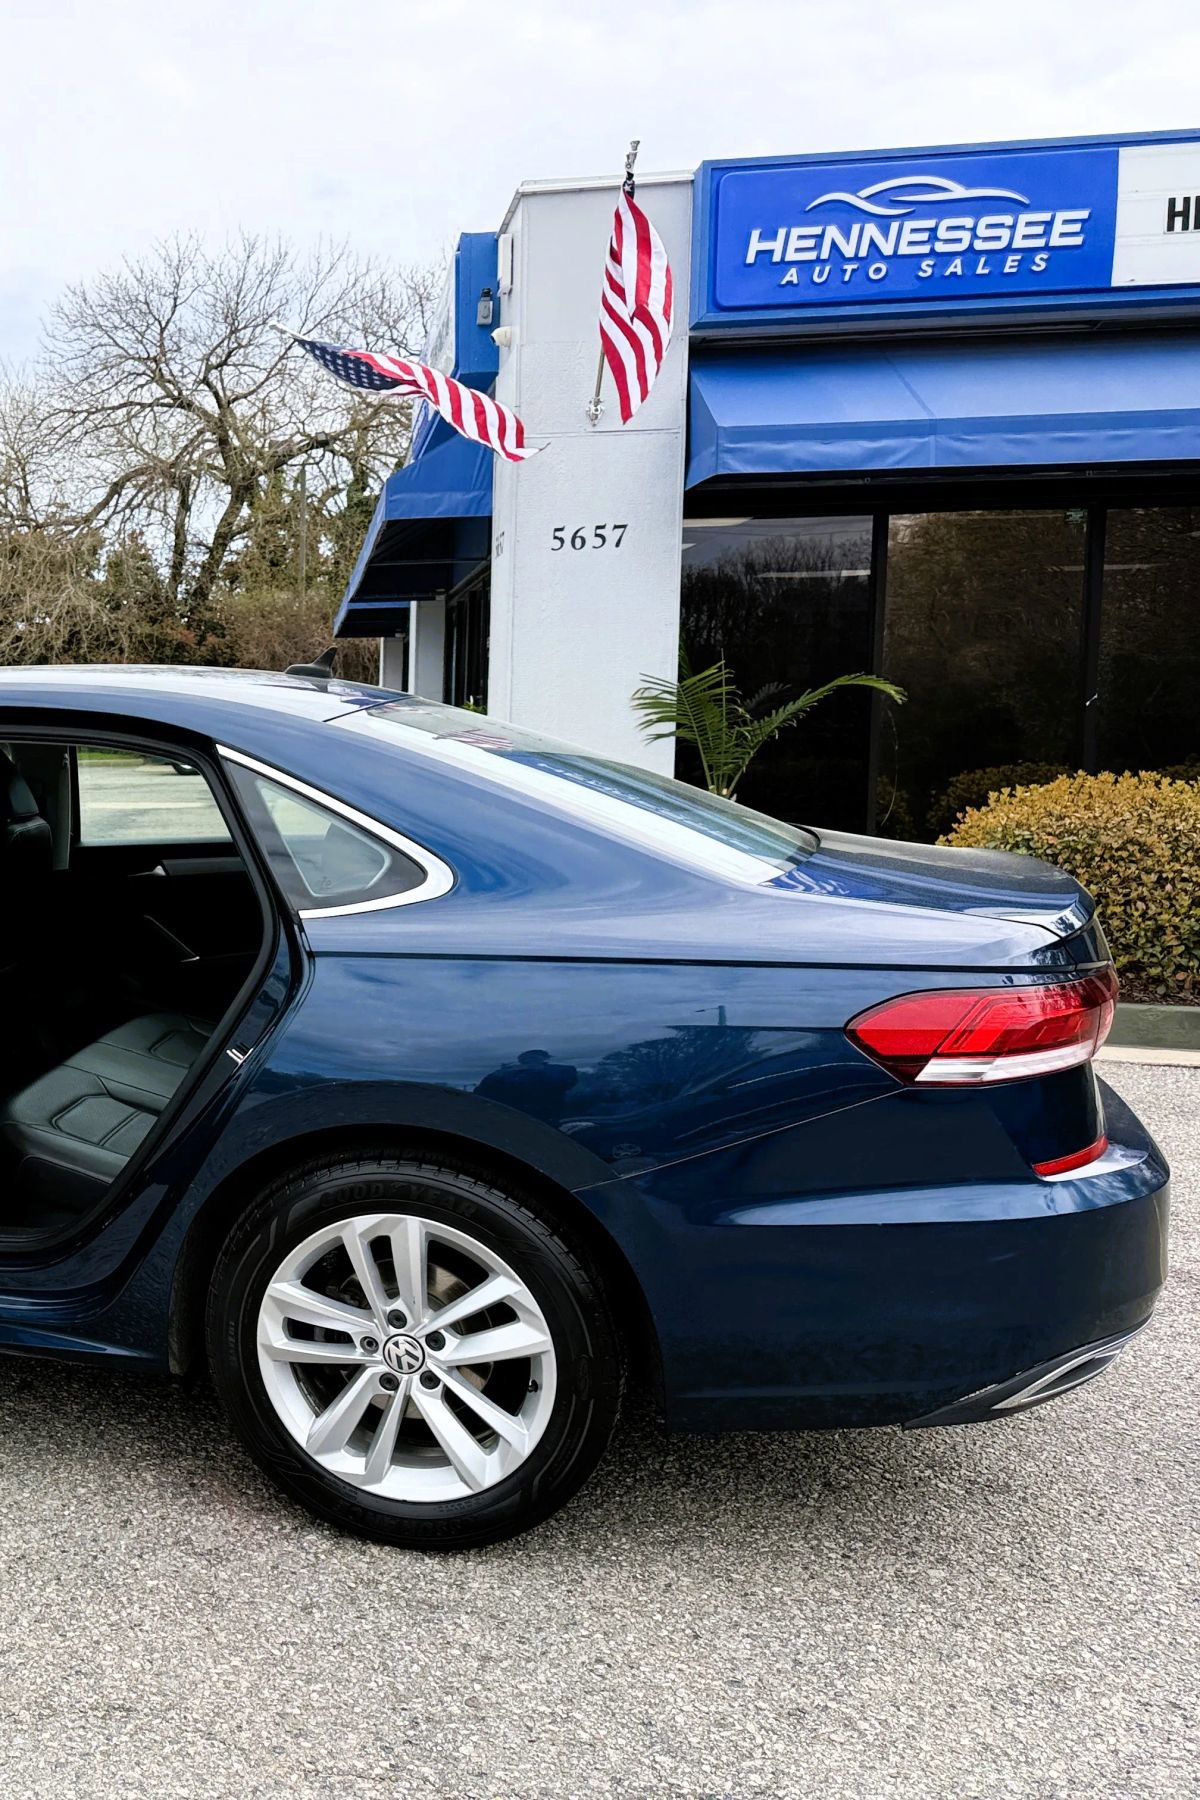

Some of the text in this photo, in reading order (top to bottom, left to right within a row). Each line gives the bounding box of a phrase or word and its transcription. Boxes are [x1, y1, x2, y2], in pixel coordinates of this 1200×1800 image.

[1166, 195, 1200, 232] H
[745, 210, 1091, 265] HENNESSEE
[780, 252, 1050, 286] AUTO SALES
[550, 523, 629, 551] 5657
